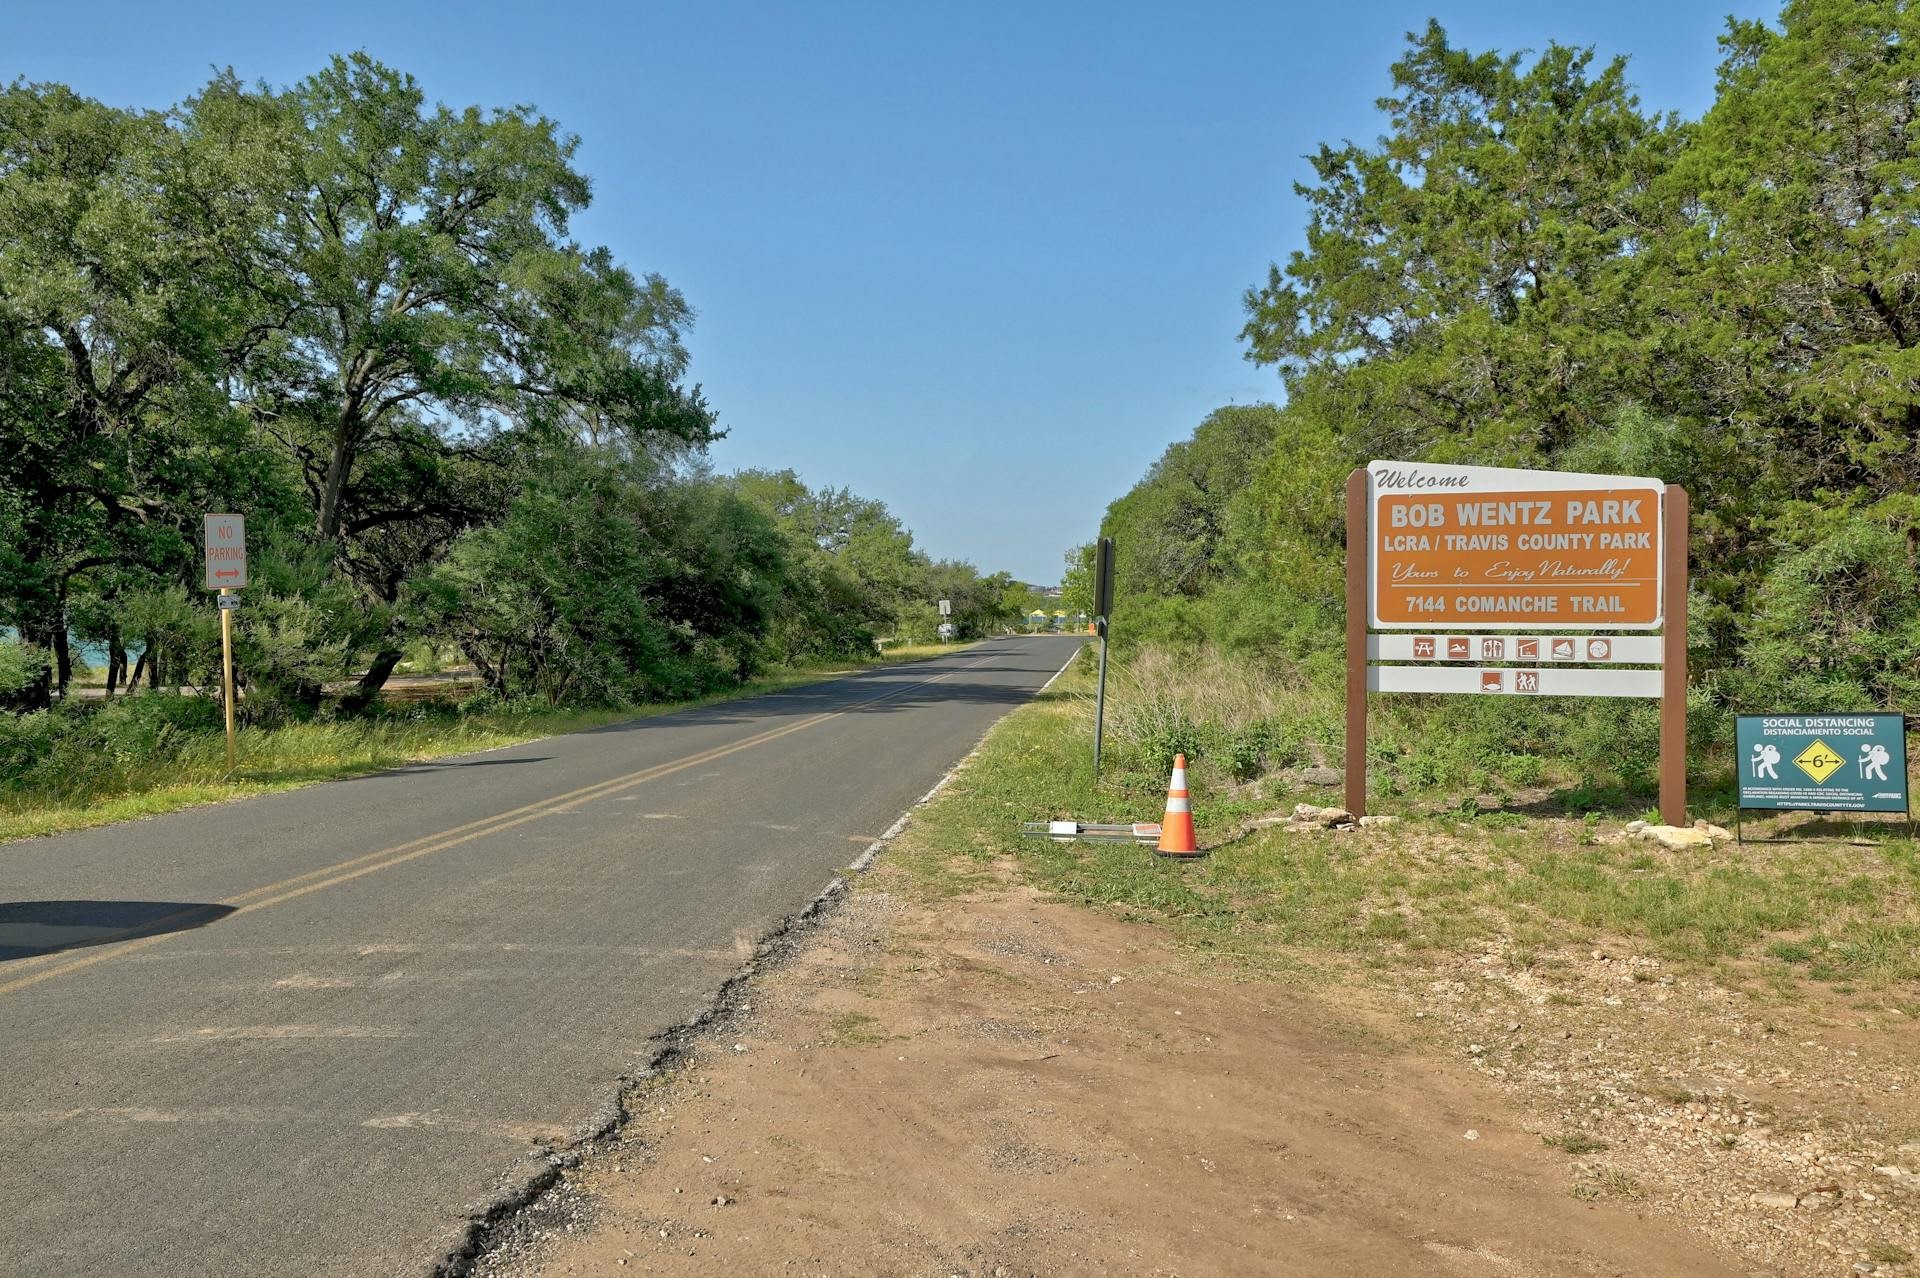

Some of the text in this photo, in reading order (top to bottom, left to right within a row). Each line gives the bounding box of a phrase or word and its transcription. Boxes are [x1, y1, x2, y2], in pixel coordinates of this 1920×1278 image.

[1375, 469, 1468, 488] Welcome
[1391, 500, 1642, 528] BOB WENTZ PARK
[218, 526, 233, 539] NO
[1385, 536, 1430, 551] LCRA
[1445, 534, 1509, 551] TRAVIS
[1518, 533, 1594, 550] COUNTY
[1600, 533, 1651, 549] PARK
[209, 547, 244, 560] PARKING
[1392, 558, 1631, 581] Yours to Enjoy Naturally!
[1407, 597, 1624, 613] 7144 COMANCHE TRAIL
[1763, 719, 1874, 728] SOCIAL DISTANCING
